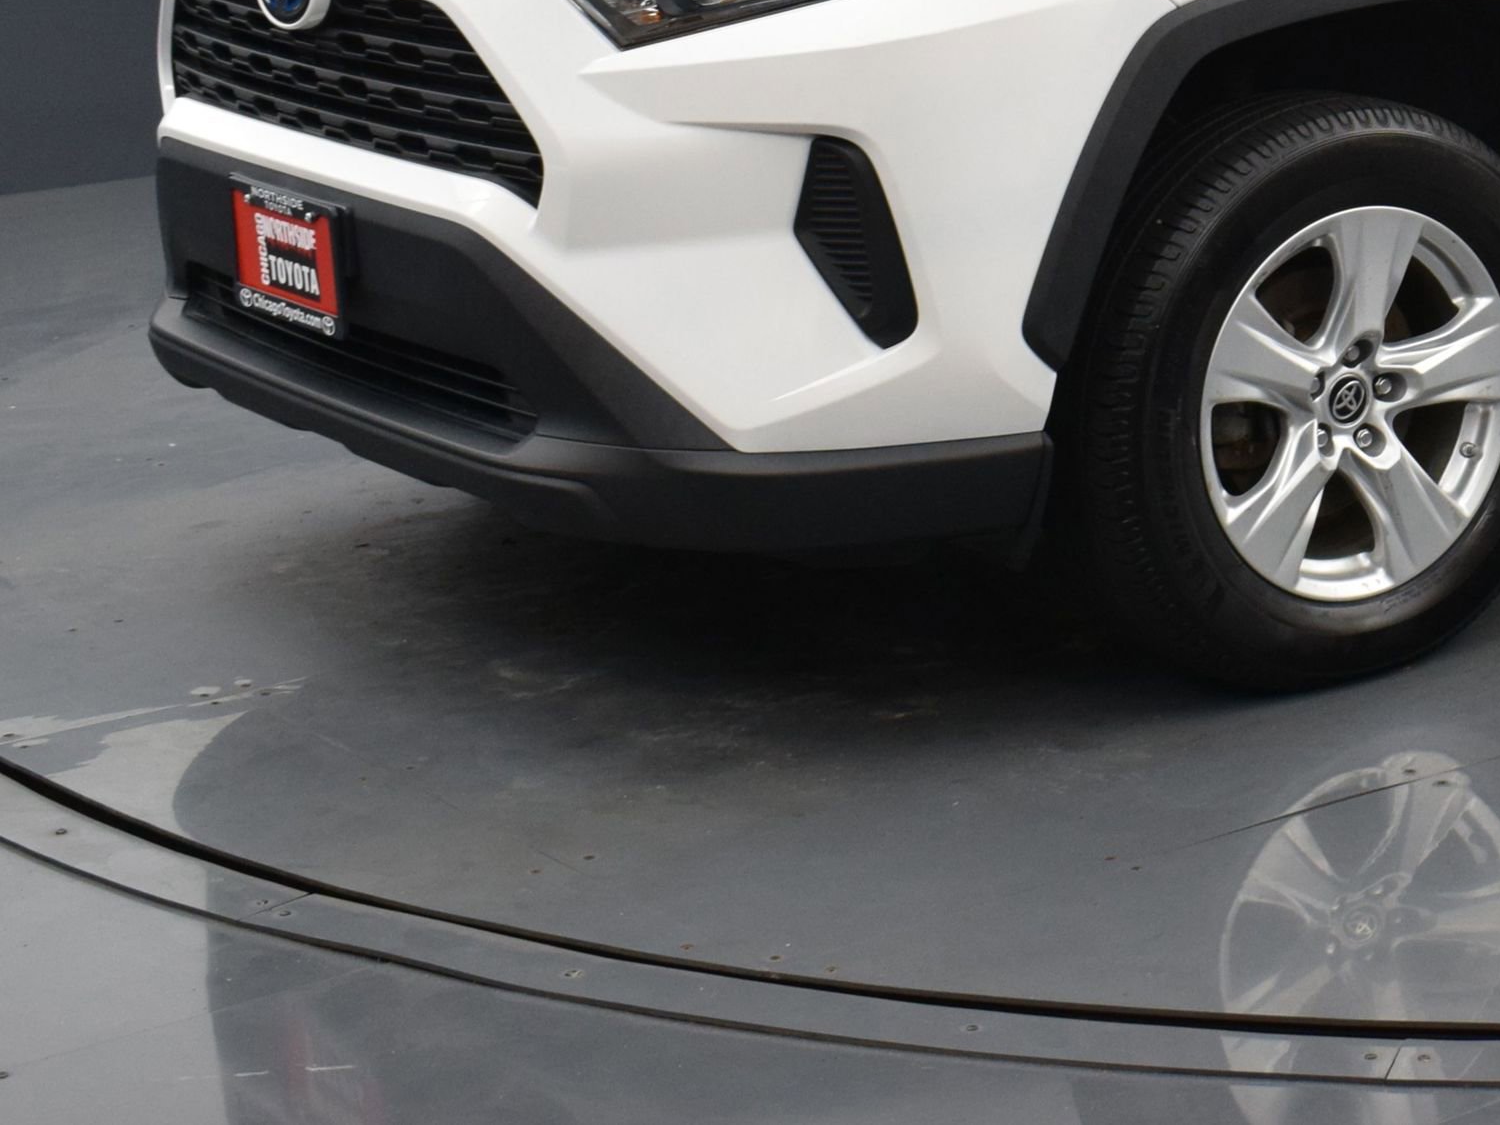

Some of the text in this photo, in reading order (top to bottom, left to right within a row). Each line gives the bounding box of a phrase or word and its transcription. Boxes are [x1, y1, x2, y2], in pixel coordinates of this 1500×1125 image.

[250, 186, 304, 211] NORTHSIDE
[264, 200, 293, 216] TOYOTA
[254, 212, 271, 285] CHICAGO
[264, 215, 317, 251] NORTHSIDE
[268, 254, 320, 296] TOYOTA
[253, 292, 322, 330] ChicagoToyota.com
